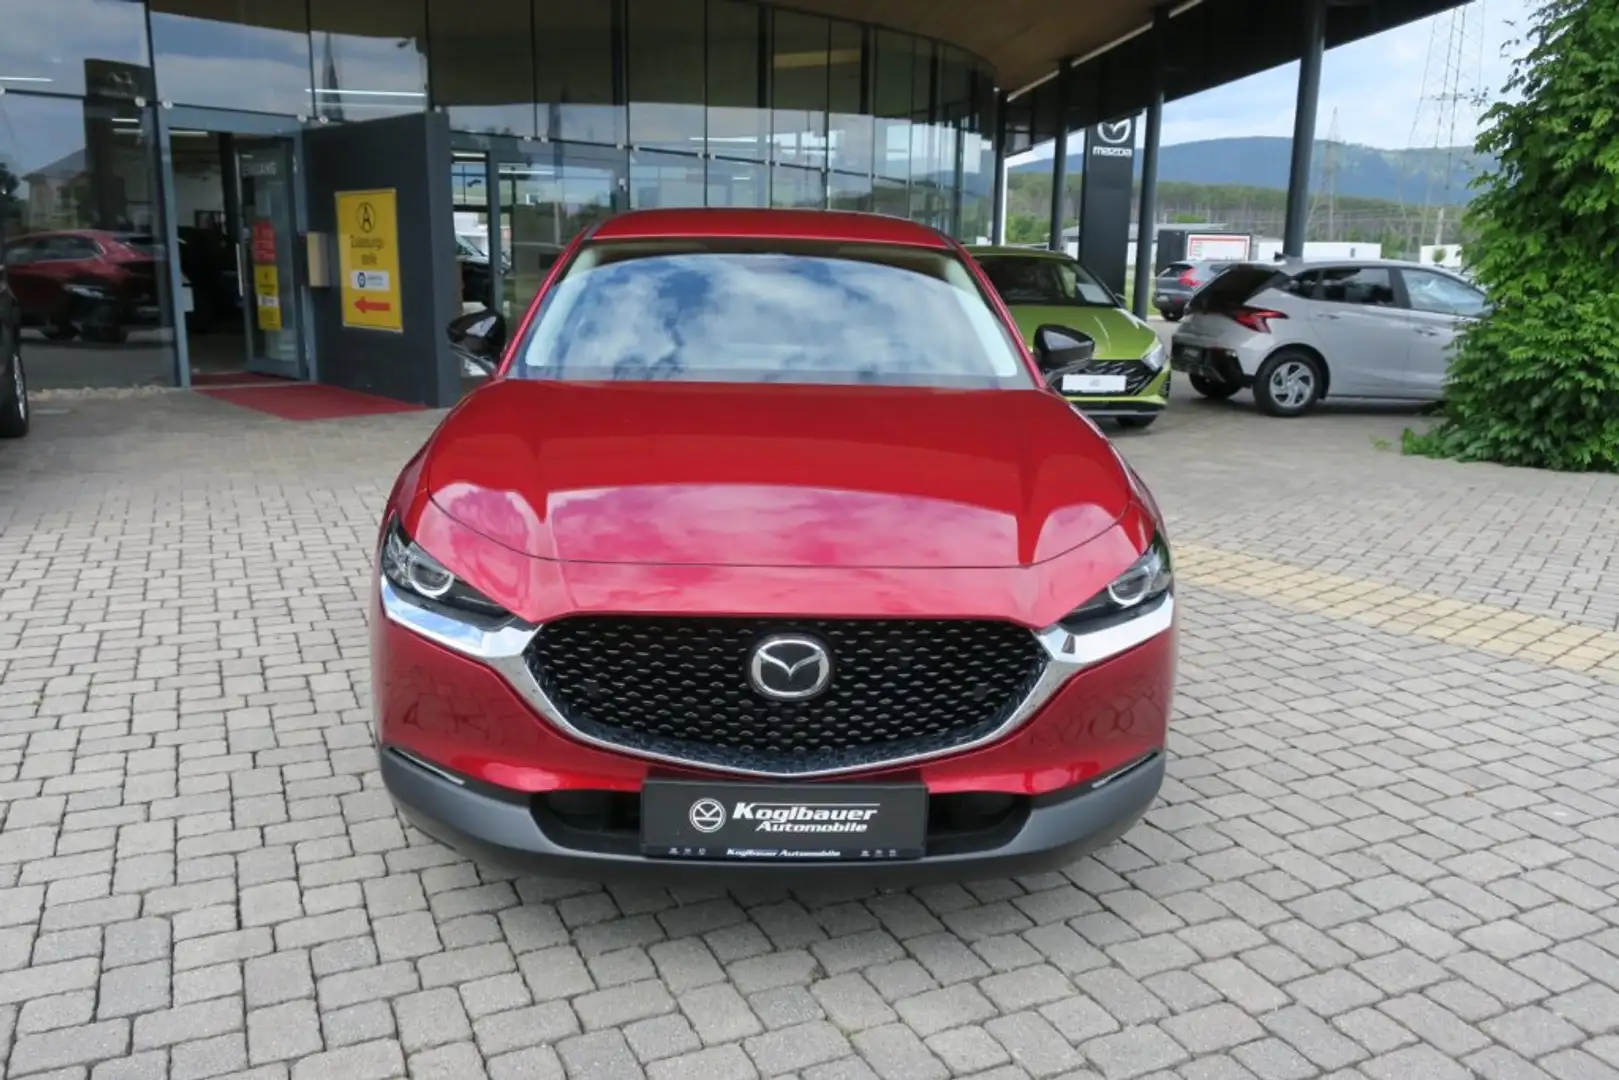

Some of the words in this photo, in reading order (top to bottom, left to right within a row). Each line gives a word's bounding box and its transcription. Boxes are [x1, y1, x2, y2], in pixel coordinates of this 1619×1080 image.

[1092, 146, 1133, 157] mazda
[732, 802, 879, 823] Koglbauer
[755, 820, 868, 832] Automobile
